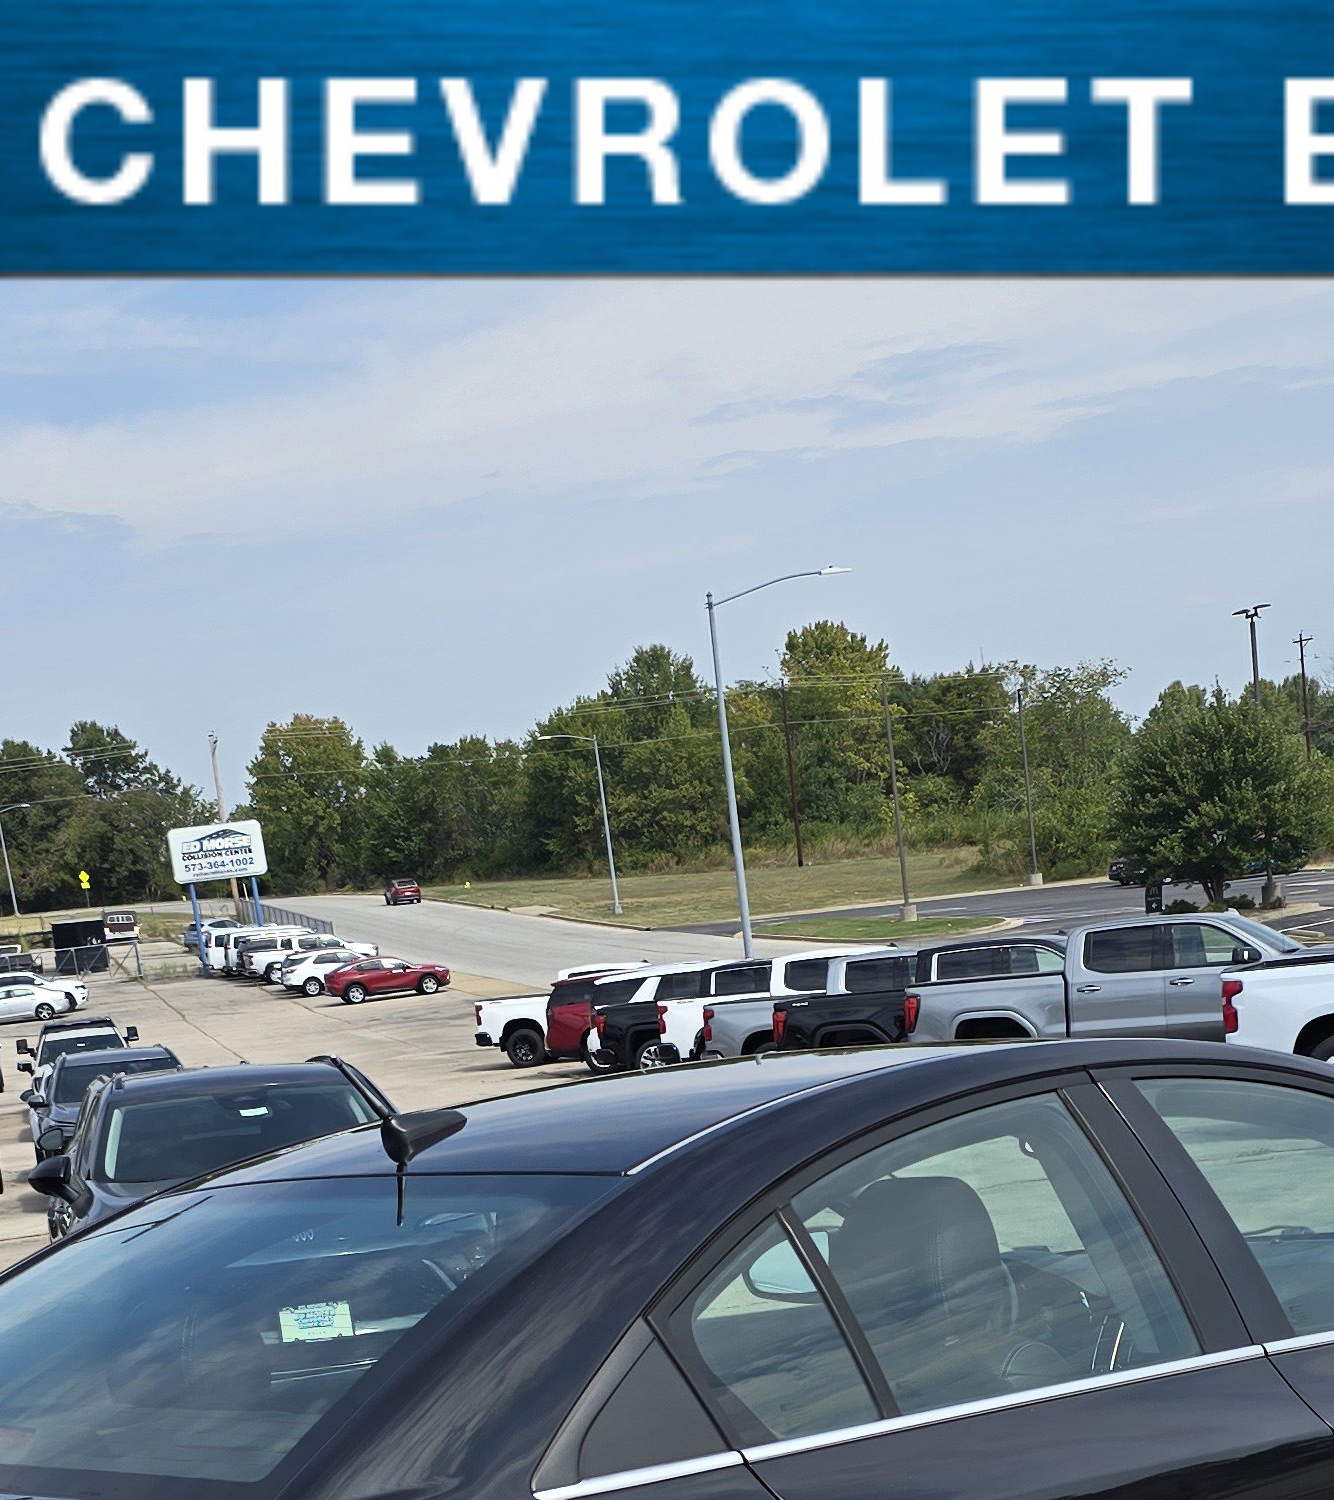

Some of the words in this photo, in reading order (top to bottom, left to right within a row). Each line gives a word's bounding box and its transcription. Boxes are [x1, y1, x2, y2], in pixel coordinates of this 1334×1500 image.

[183, 841, 201, 853] ED
[202, 835, 251, 851] MORSE
[182, 850, 223, 861] COLLISION
[225, 848, 253, 857] CENTER
[185, 857, 254, 872] 573-364-1002
